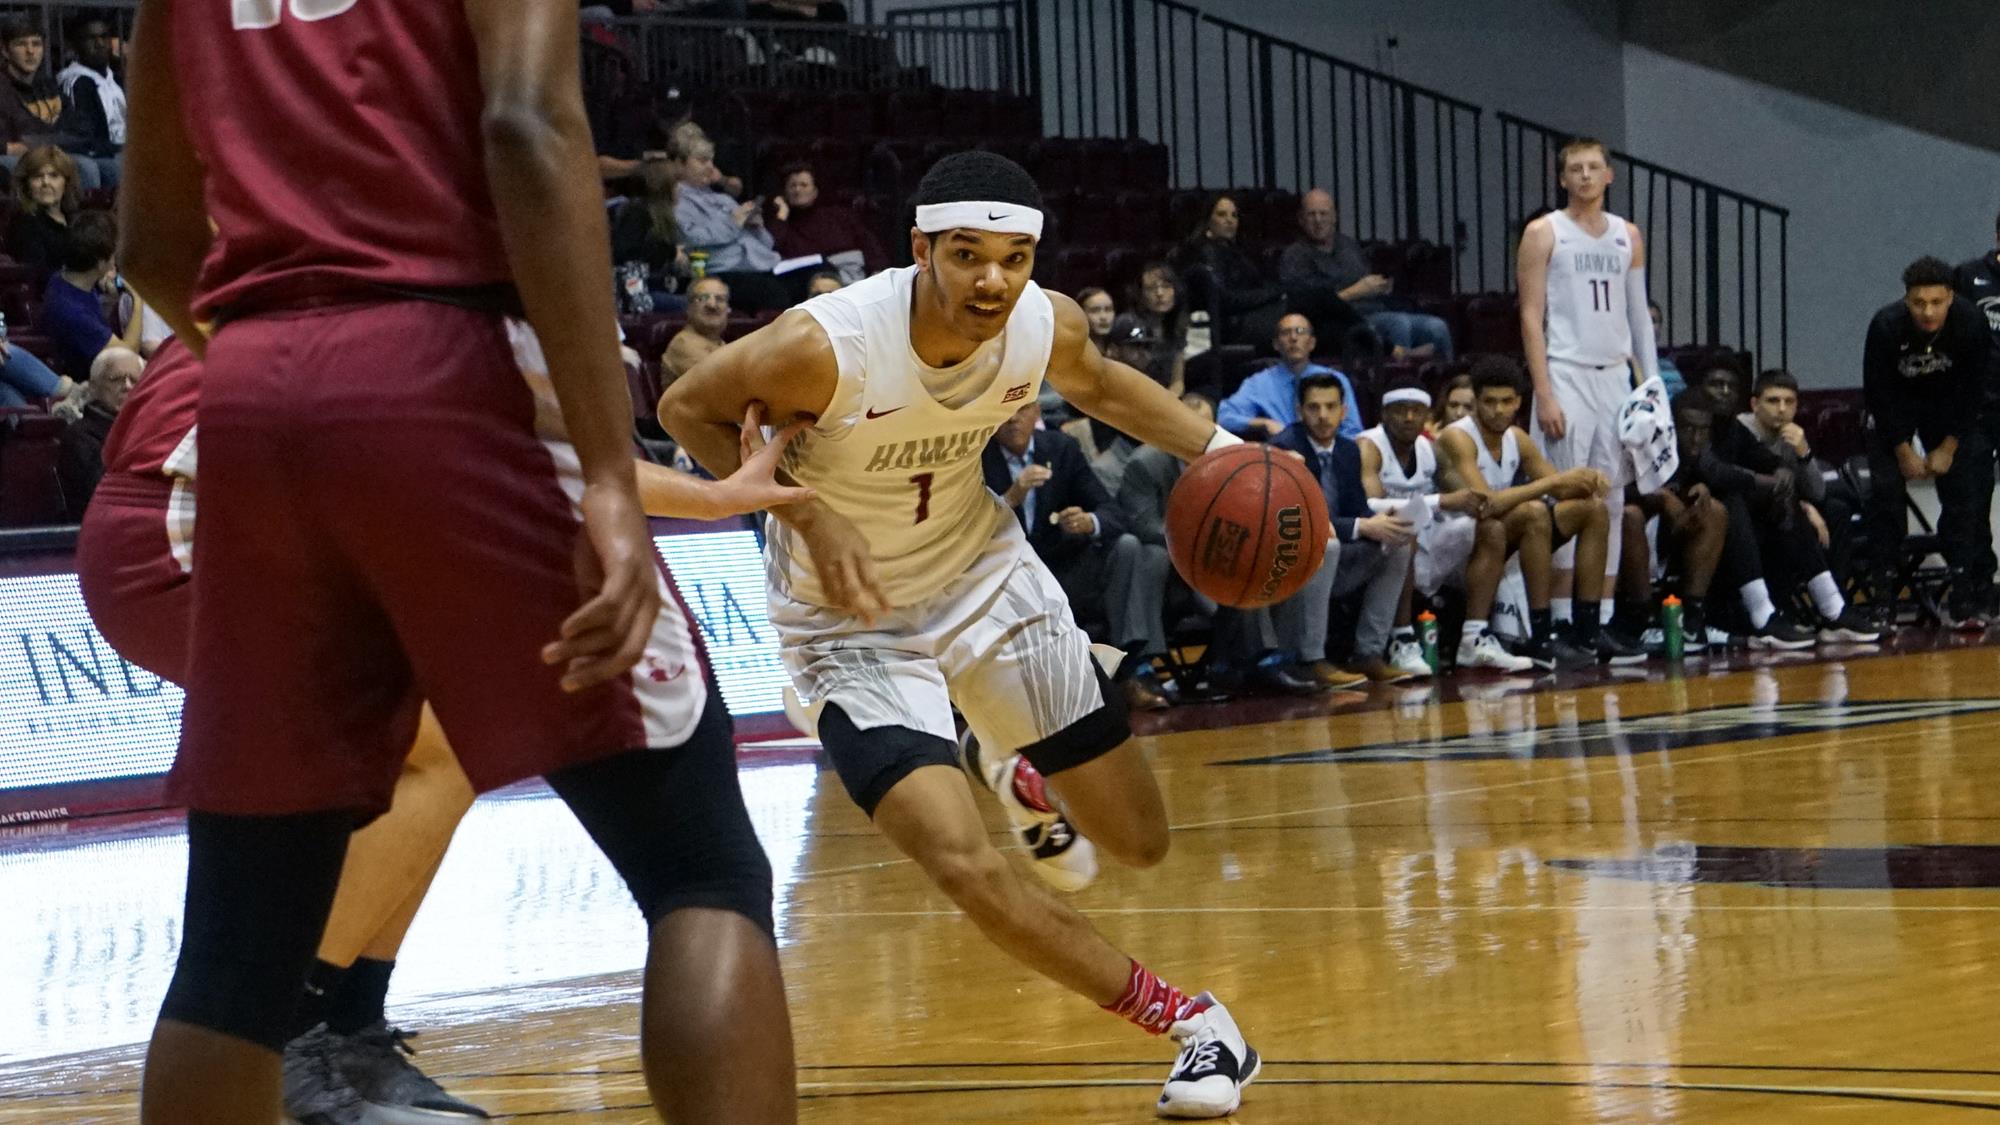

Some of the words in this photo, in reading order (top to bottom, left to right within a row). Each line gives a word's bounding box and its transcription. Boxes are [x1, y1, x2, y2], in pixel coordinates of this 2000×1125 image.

[1574, 253, 1621, 274] HAWKS
[1588, 279, 1611, 312] 11
[908, 471, 934, 525] 1
[0, 807, 69, 824] AKTRONICS
